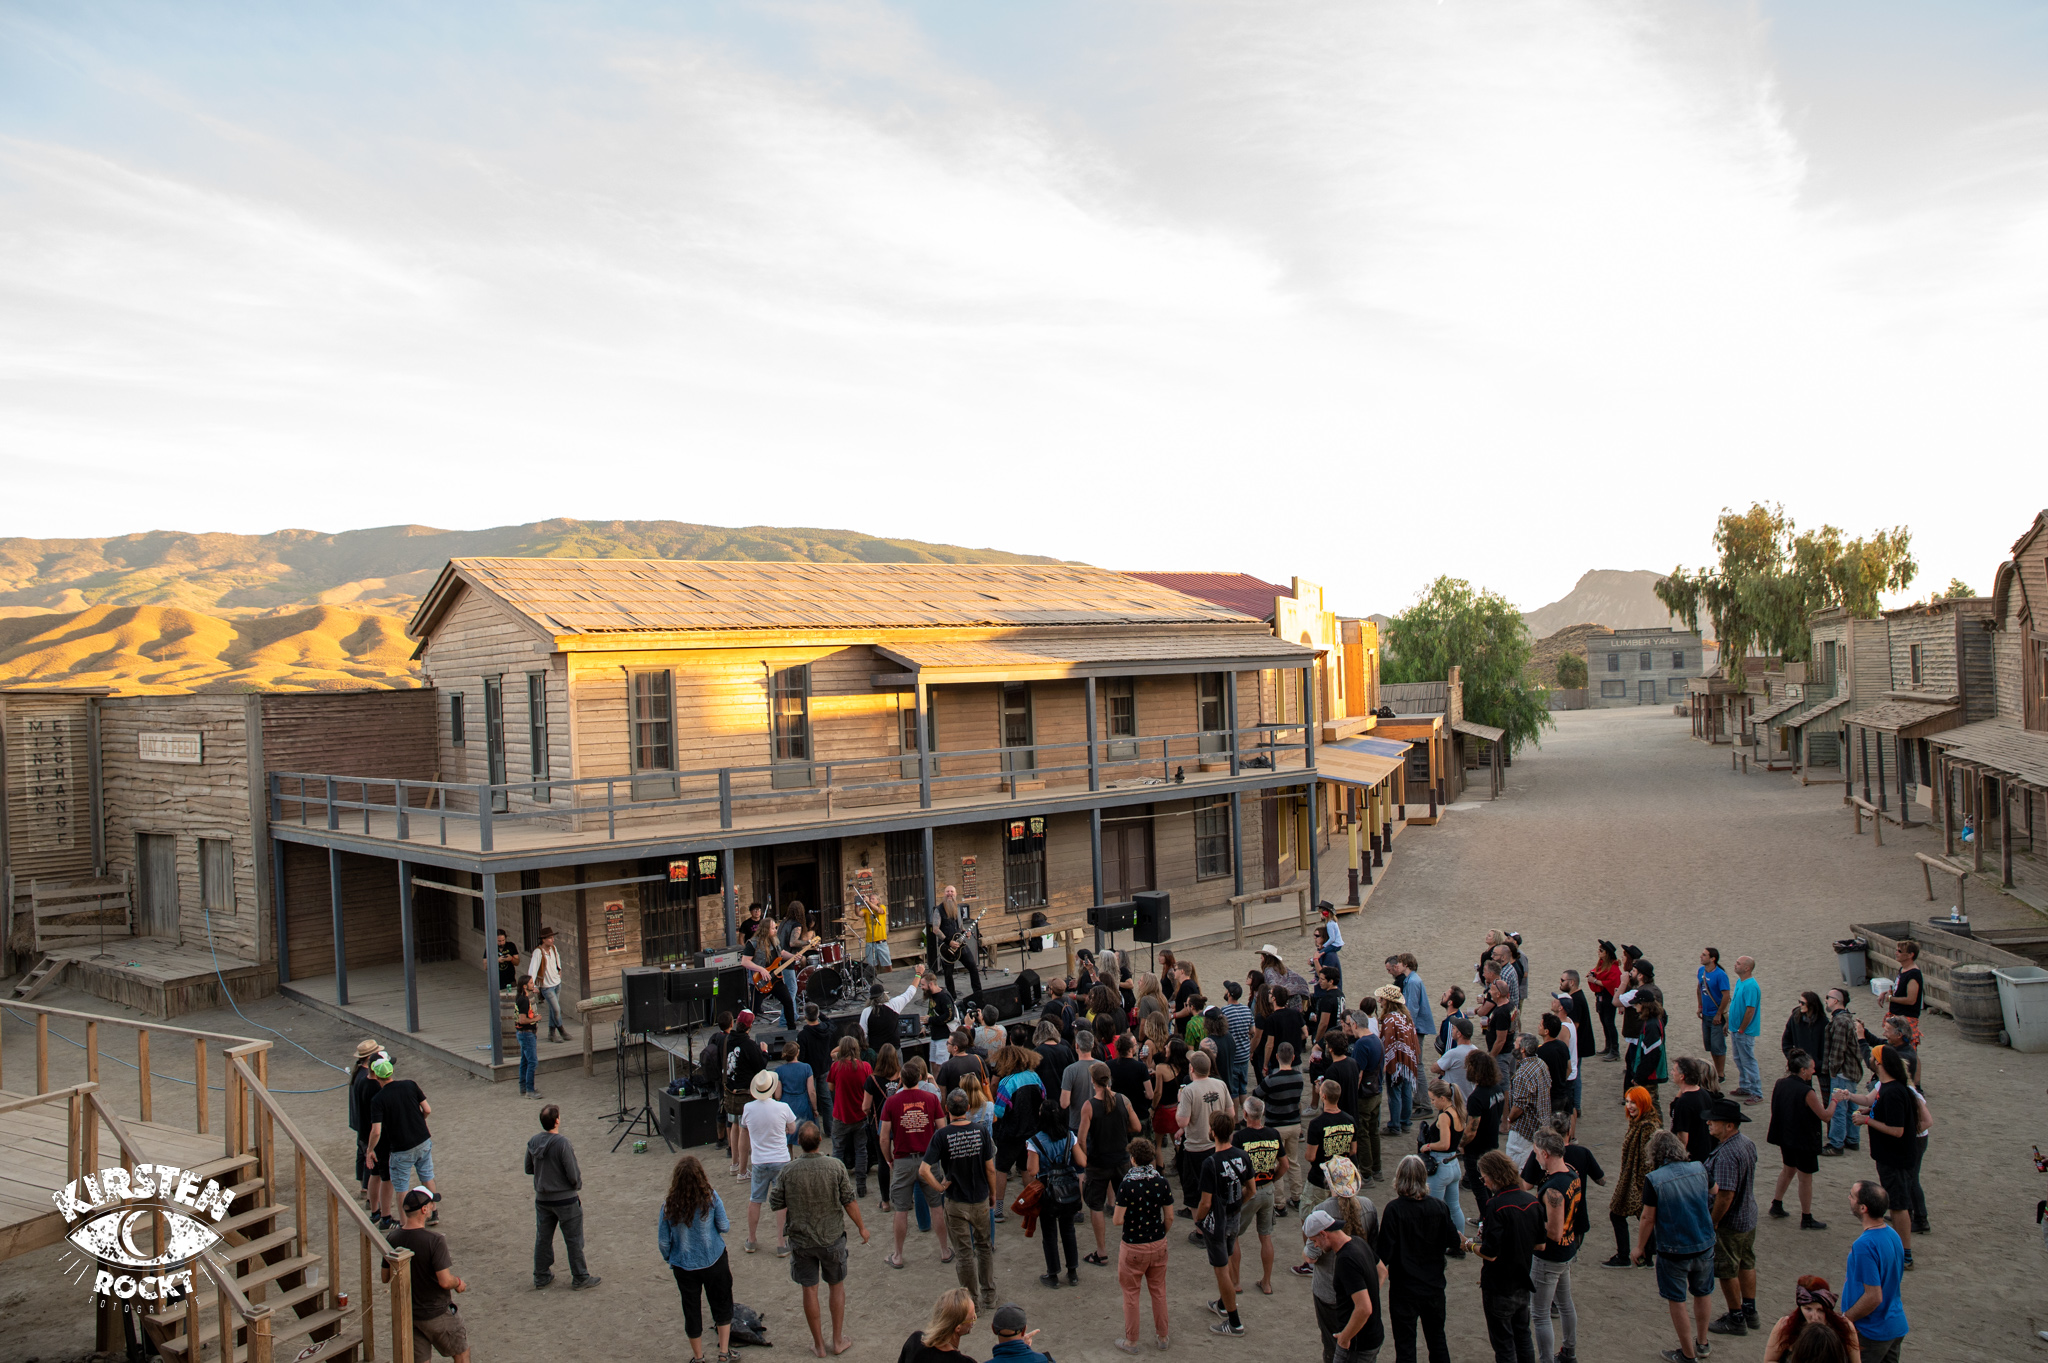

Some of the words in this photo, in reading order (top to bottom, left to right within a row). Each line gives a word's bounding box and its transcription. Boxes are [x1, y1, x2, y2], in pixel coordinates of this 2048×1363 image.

[1611, 639, 1651, 647] LUMBER
[1653, 637, 1679, 645] YARD
[29, 720, 45, 813] MINING
[141, 735, 158, 756] HAY
[161, 736, 168, 757] &
[171, 736, 198, 758] FEED
[52, 720, 67, 844] EXCHANGE
